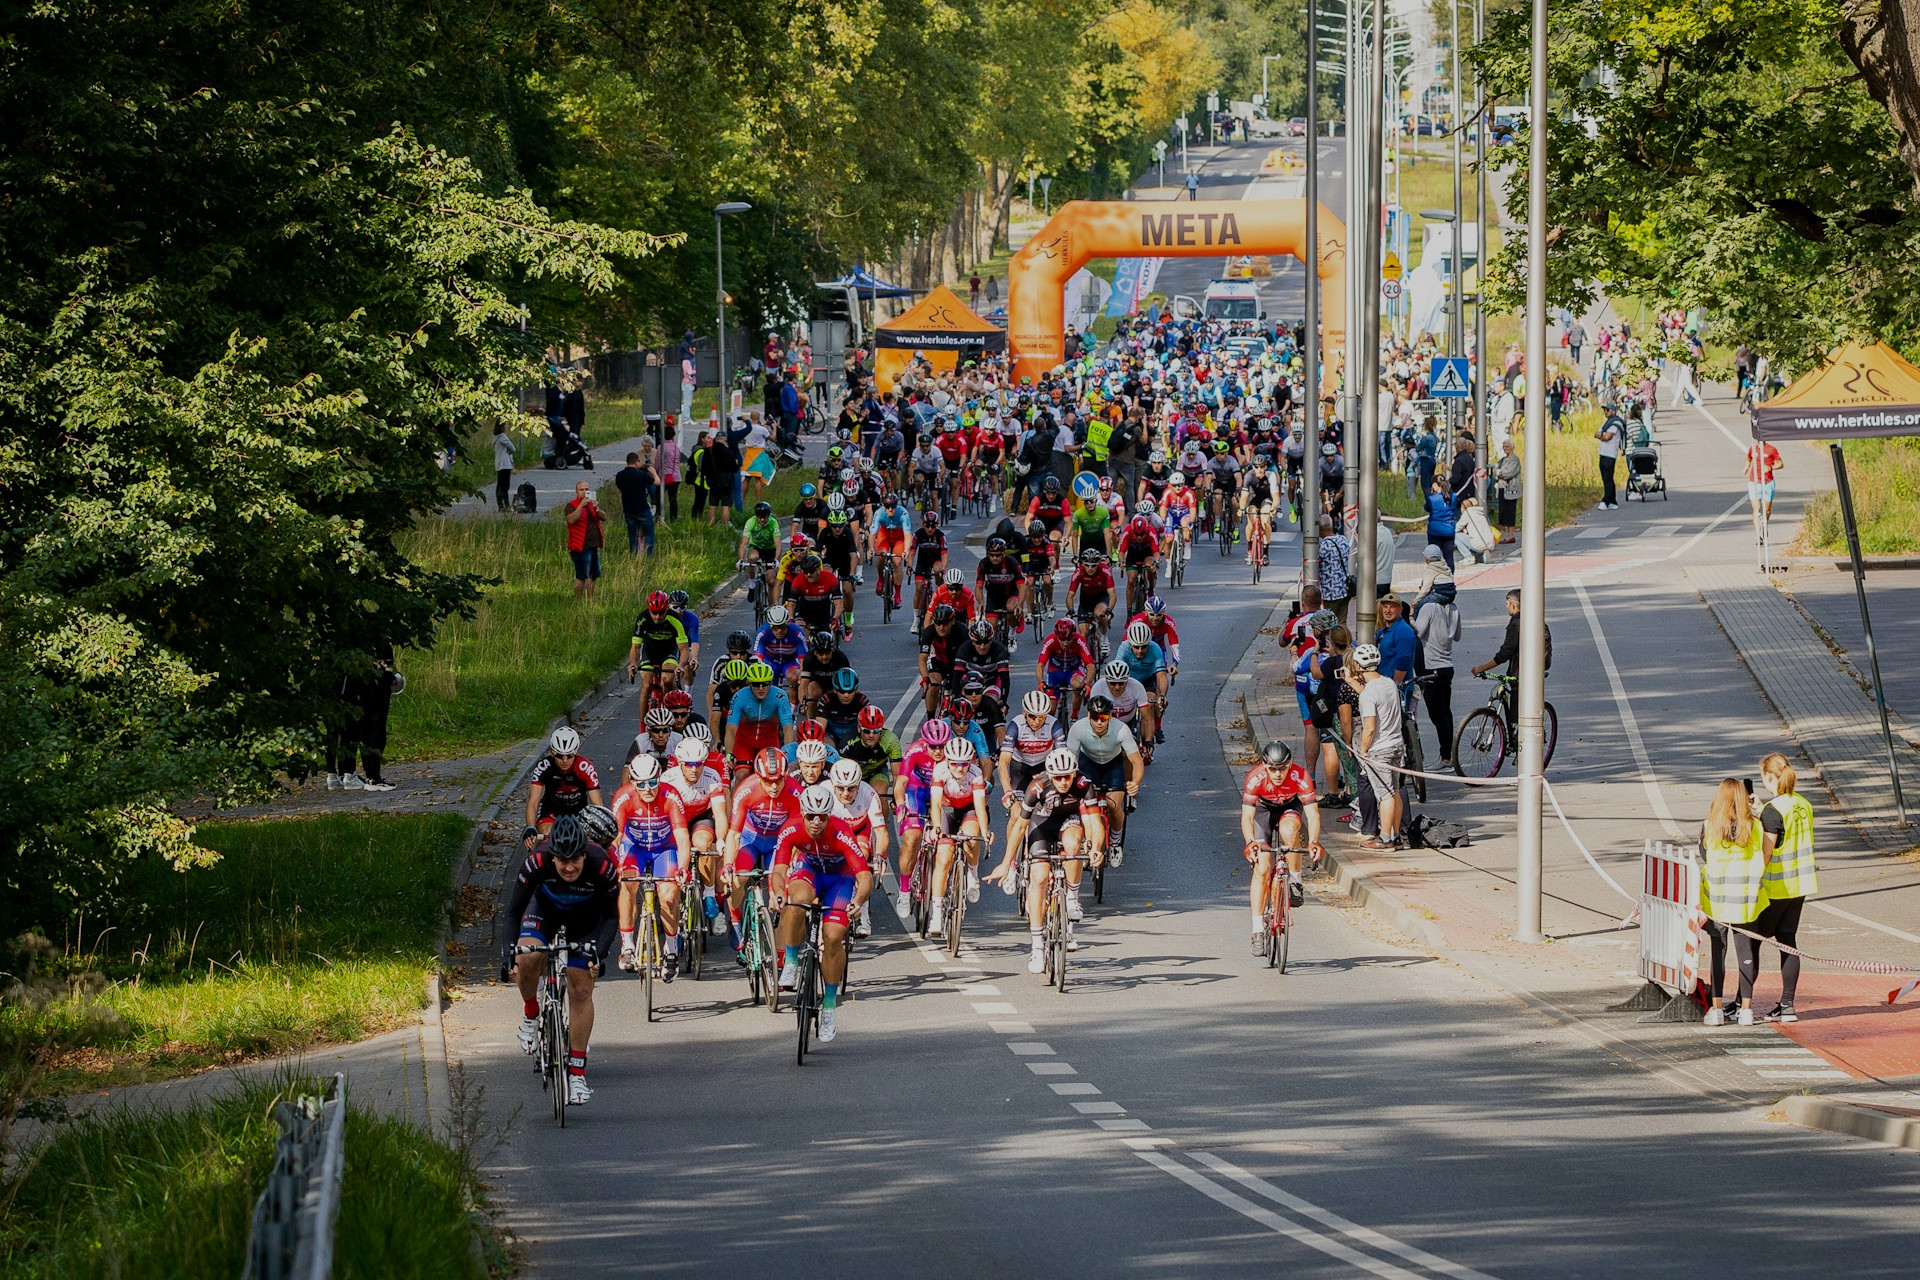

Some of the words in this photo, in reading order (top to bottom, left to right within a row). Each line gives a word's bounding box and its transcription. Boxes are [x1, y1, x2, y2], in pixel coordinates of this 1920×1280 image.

[1141, 213, 1241, 246] META
[1386, 284, 1400, 294] 20
[1829, 394, 1908, 405] HERKULES
[1090, 425, 1108, 436] FOTO
[1794, 412, 1920, 430] www.herkules.or
[578, 760, 600, 788] ORCA
[555, 791, 583, 800] ORCA
[664, 791, 687, 815] bekom
[732, 787, 751, 815] bekom
[773, 825, 798, 851] bekom
[836, 830, 865, 858] bekom
